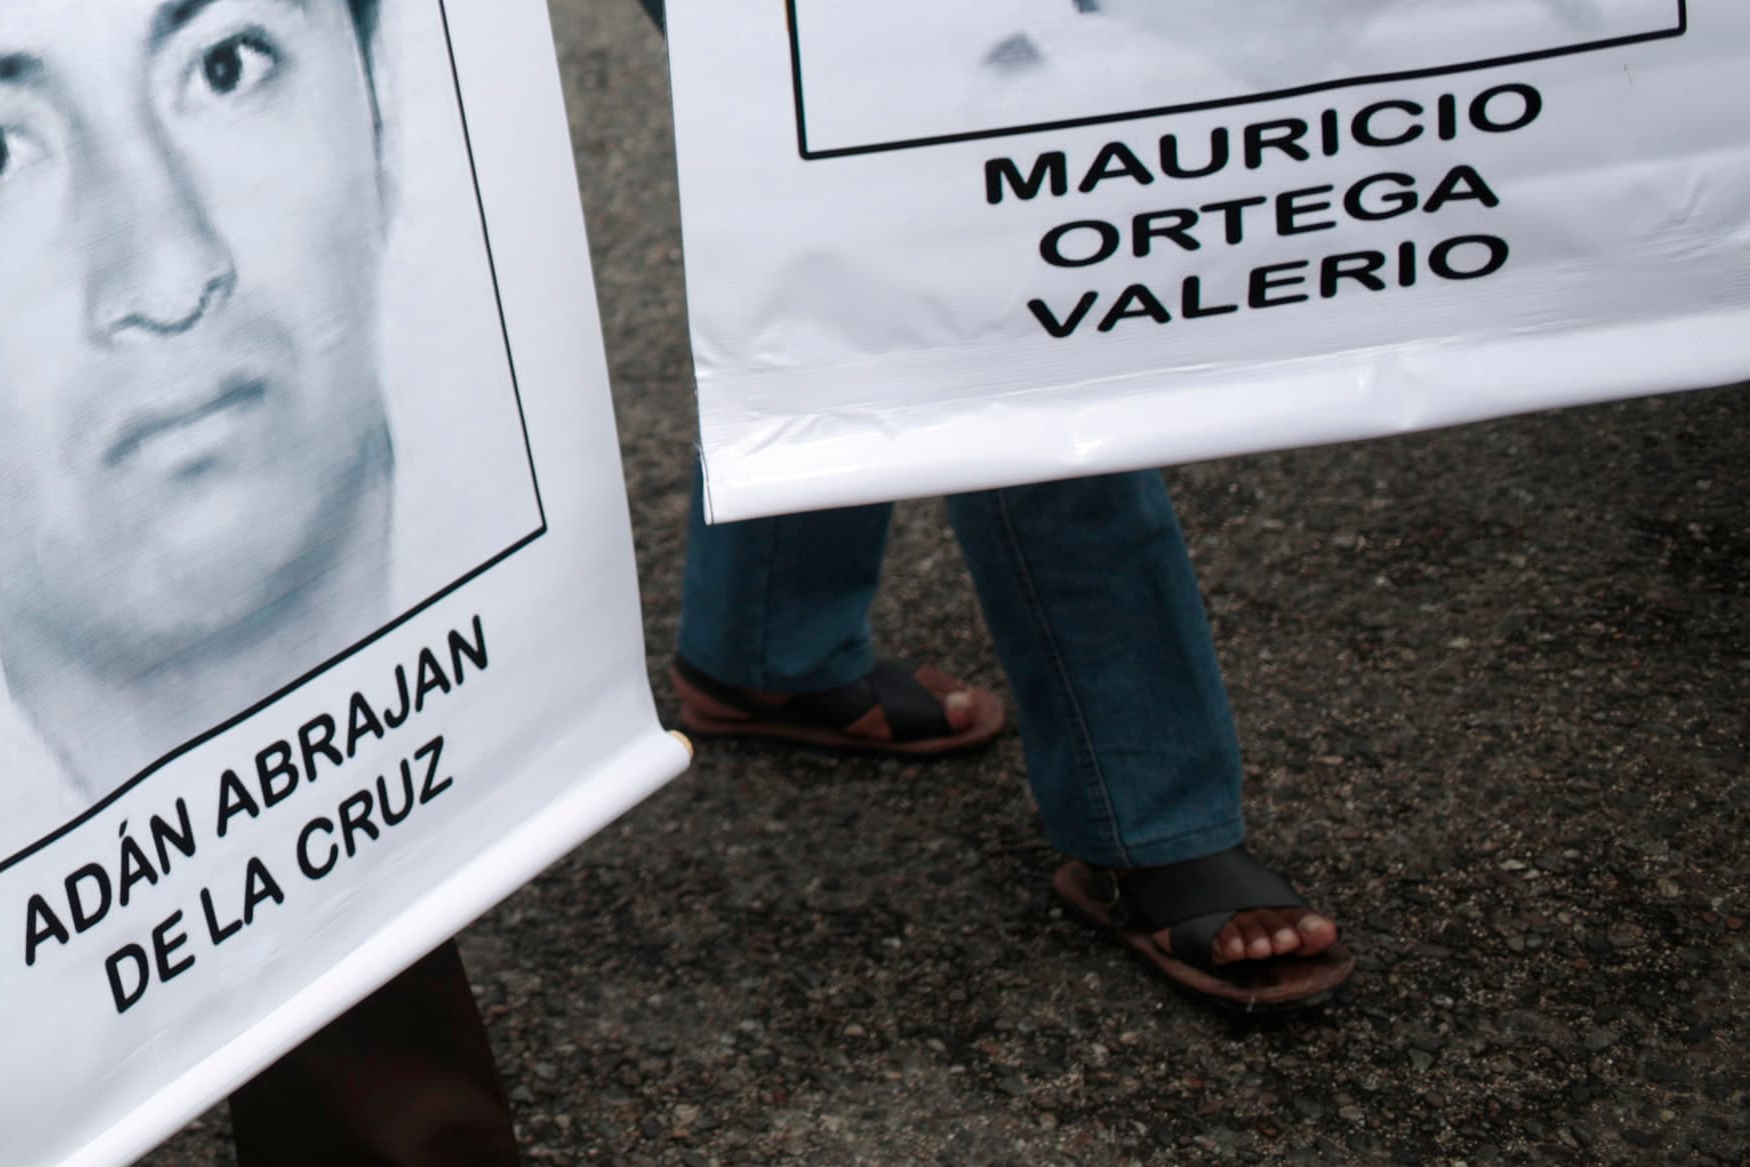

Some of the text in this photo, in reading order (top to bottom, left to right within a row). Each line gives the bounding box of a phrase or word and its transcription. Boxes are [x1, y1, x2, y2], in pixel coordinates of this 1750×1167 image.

[984, 83, 1543, 205] MAURICIO
[1039, 164, 1500, 268] ORTEGA
[1026, 234, 1509, 338] VALERIO
[24, 614, 489, 967] ADÁN ABRAJAN
[104, 734, 454, 1015] DE LA CRUZ
